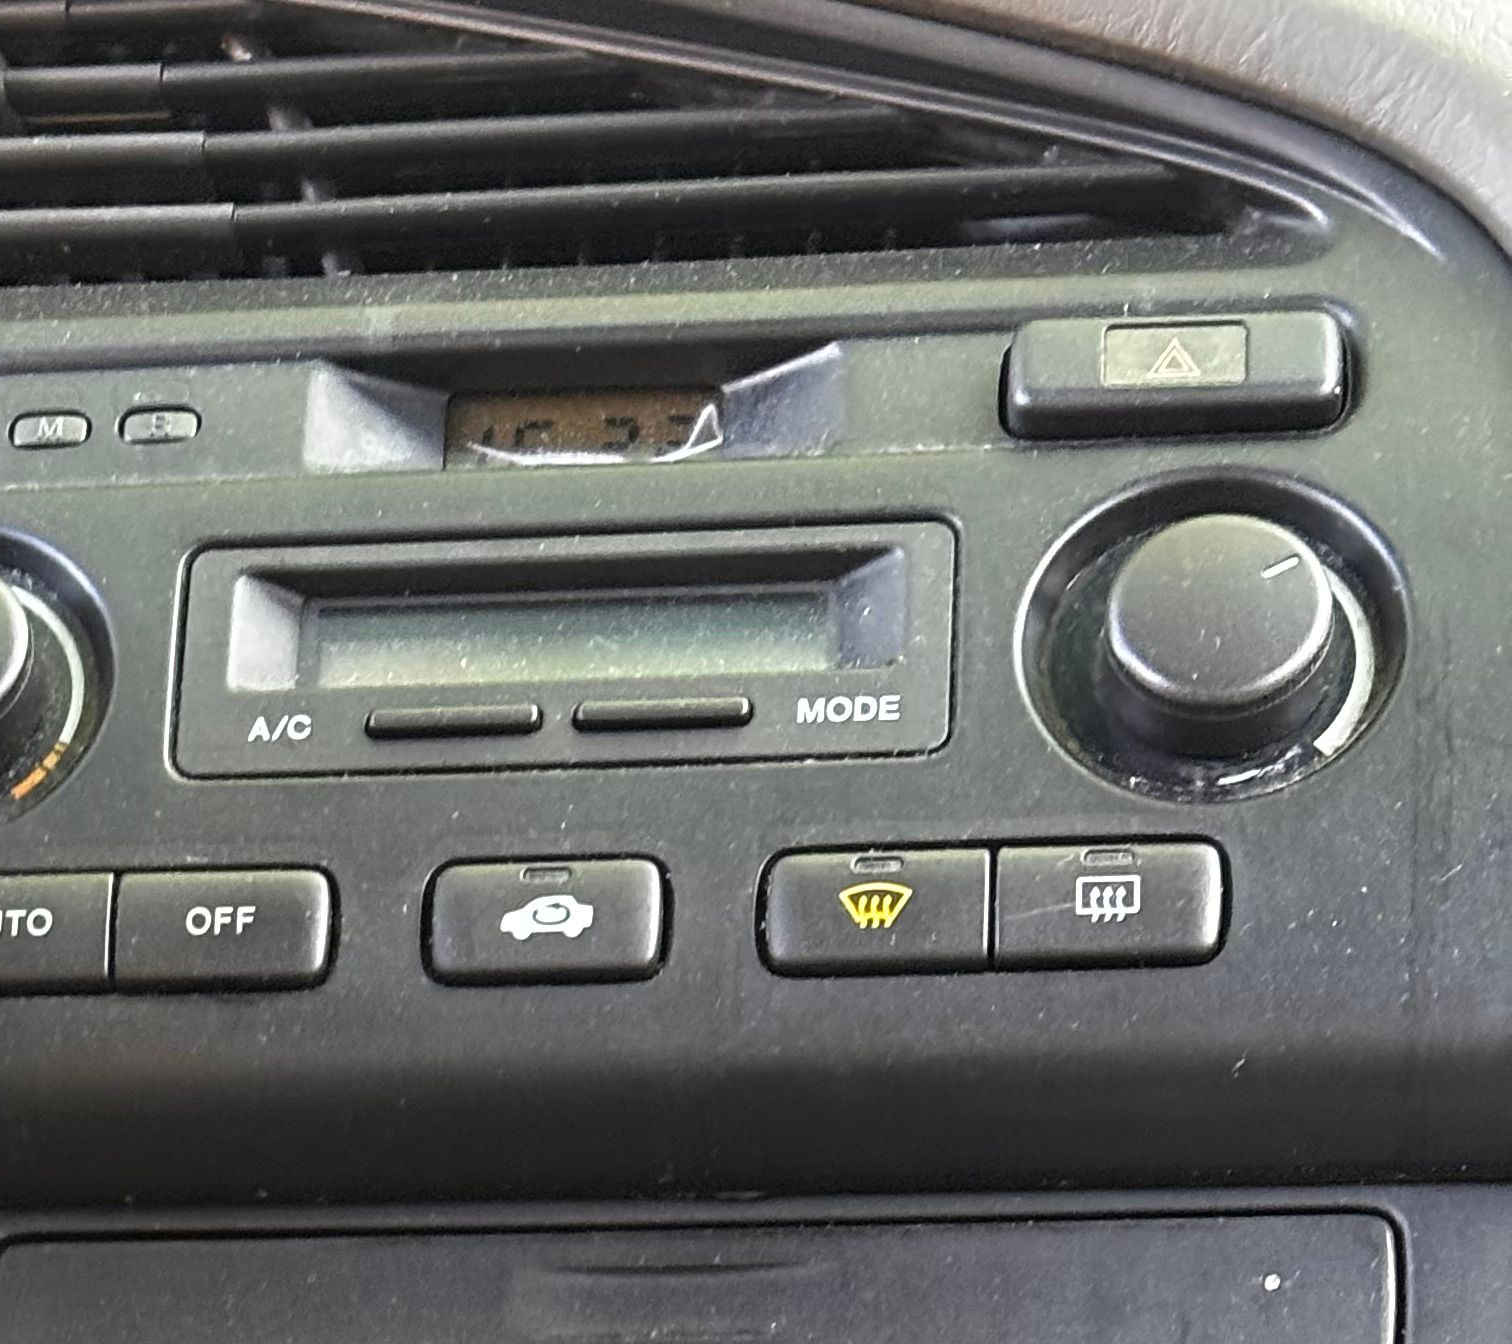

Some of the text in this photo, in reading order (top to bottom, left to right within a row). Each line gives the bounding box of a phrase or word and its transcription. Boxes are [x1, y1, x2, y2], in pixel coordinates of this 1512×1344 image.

[39, 416, 66, 437] M
[796, 694, 901, 724] MODE
[247, 714, 312, 743] A/C
[185, 905, 256, 936] OFF
